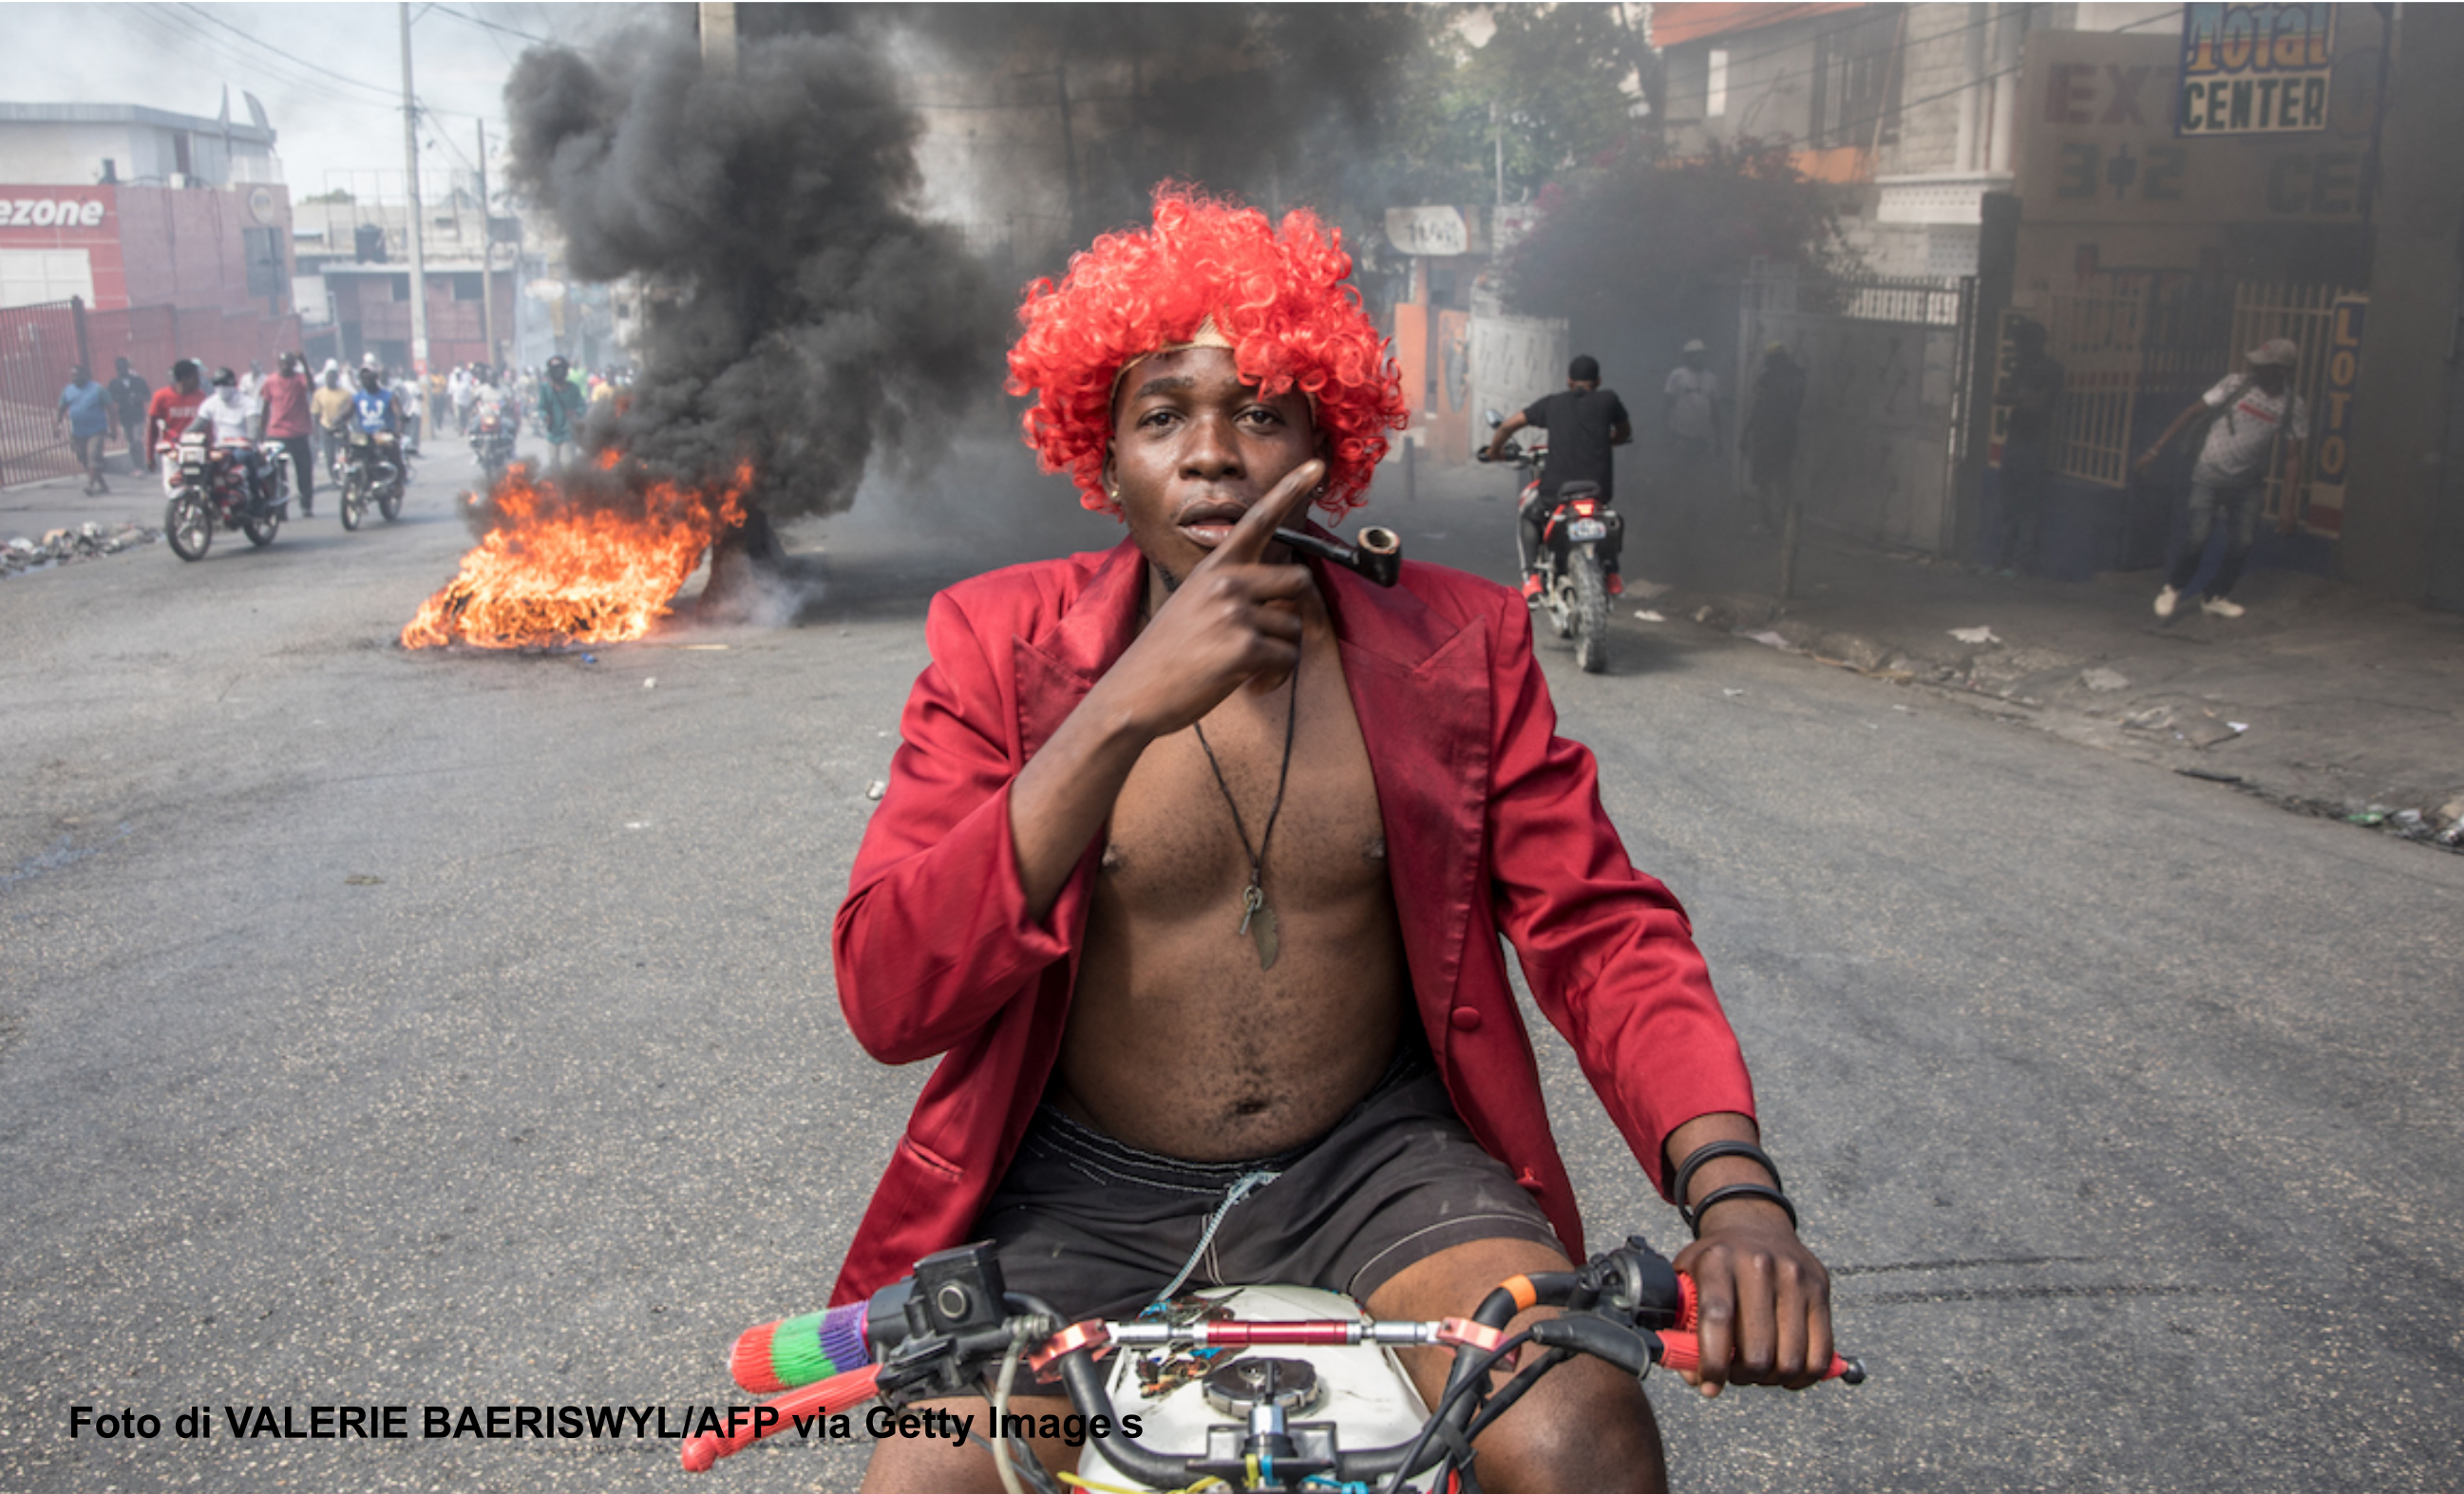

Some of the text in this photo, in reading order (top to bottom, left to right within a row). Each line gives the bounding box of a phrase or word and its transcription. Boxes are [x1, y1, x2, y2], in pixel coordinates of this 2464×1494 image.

[2184, 3, 2328, 74] Total
[2182, 77, 2325, 130] CENTER
[2321, 308, 2359, 475] LOTO
